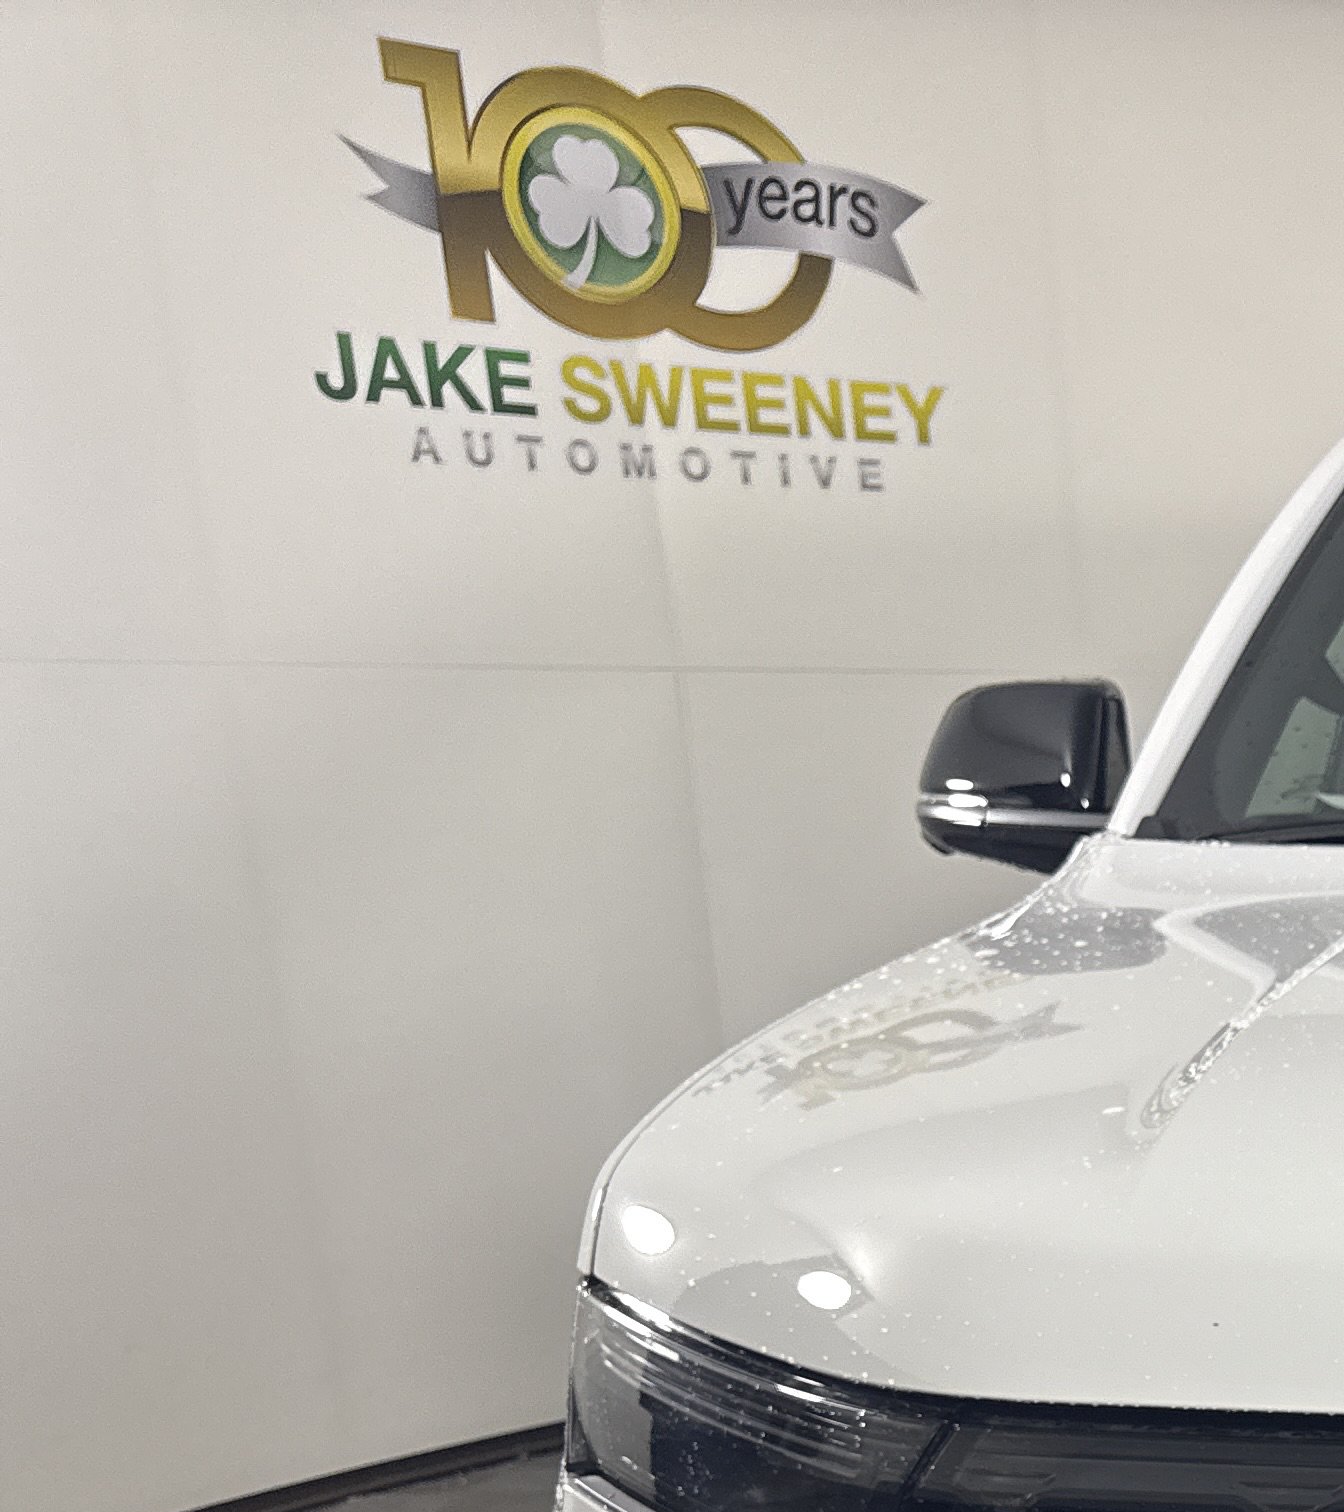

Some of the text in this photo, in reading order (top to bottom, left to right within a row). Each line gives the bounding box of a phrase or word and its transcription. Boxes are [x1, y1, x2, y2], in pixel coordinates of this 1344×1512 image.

[722, 174, 880, 240] years
[314, 330, 945, 446] JAKE SWEENEY
[409, 426, 887, 494] AUTOMOTIVE
